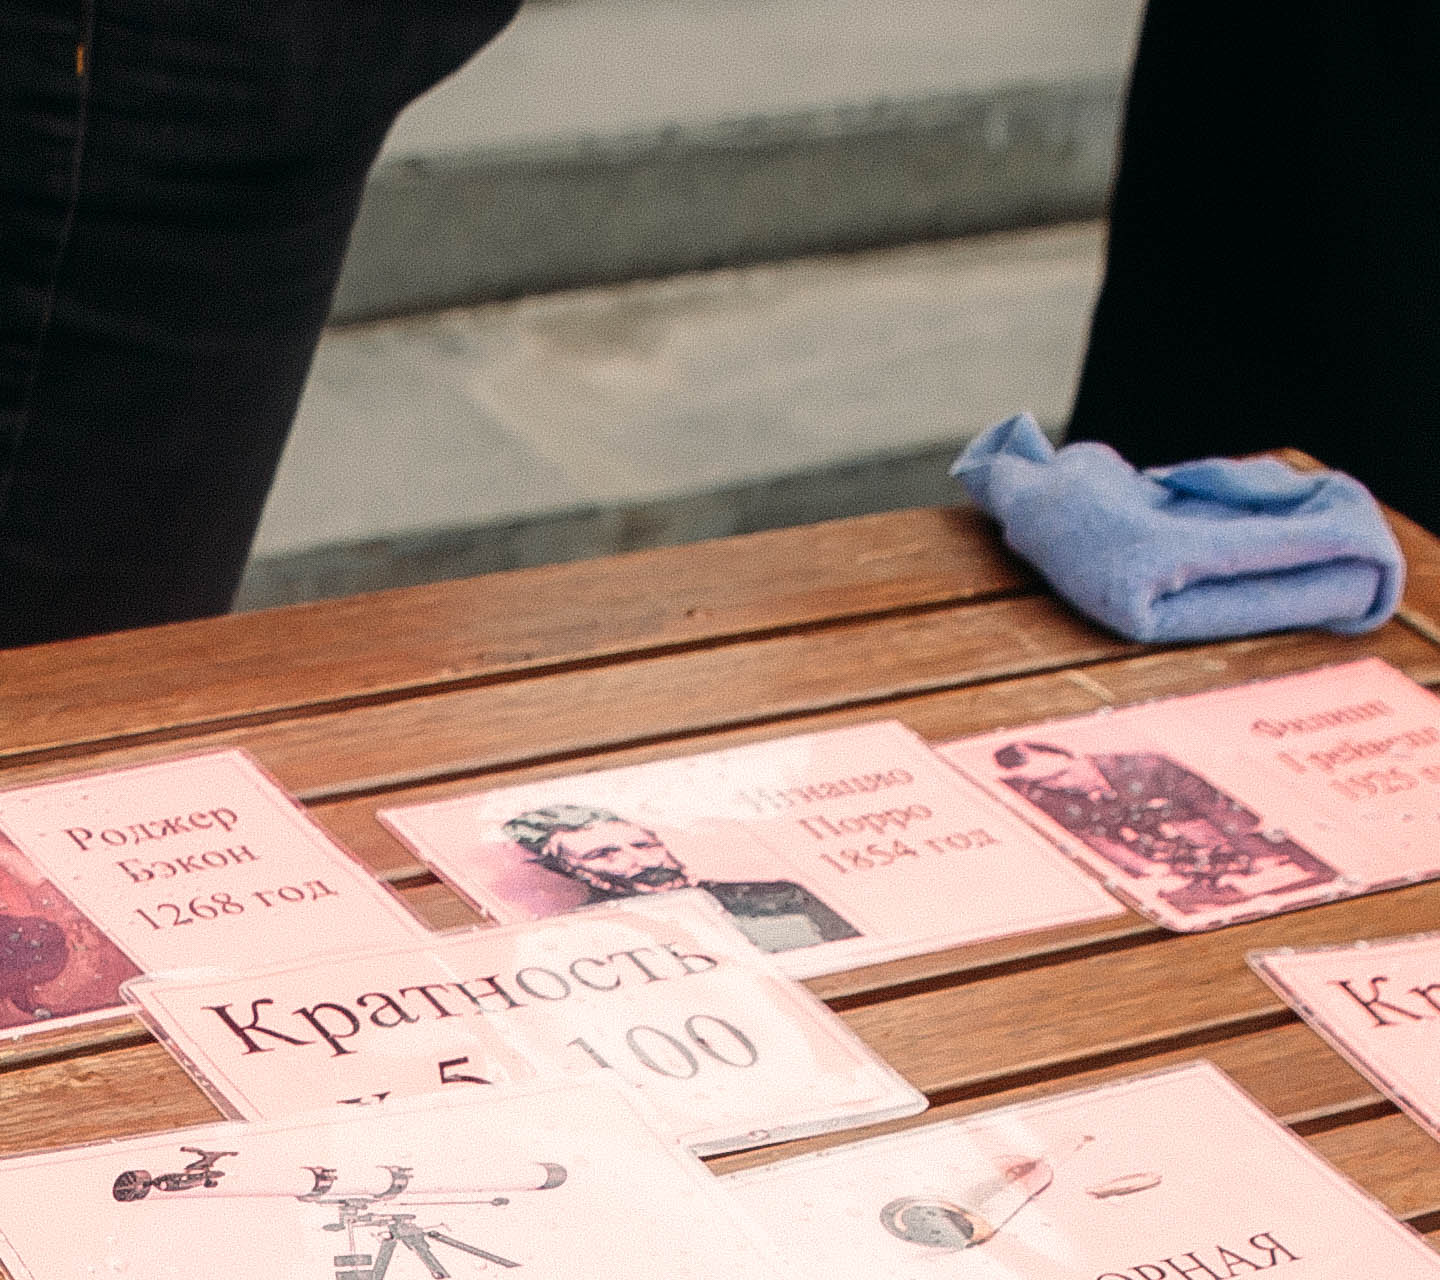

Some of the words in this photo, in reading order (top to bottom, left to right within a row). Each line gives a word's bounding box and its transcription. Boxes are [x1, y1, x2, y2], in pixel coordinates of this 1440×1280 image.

[64, 806, 239, 850] Роджер
[798, 804, 932, 839] Порро
[115, 845, 260, 883] Бэкон
[822, 840, 919, 873] 1854
[925, 828, 999, 853] год
[135, 892, 244, 929] 1268
[252, 879, 338, 907] год
[202, 942, 721, 1059] Кратность
